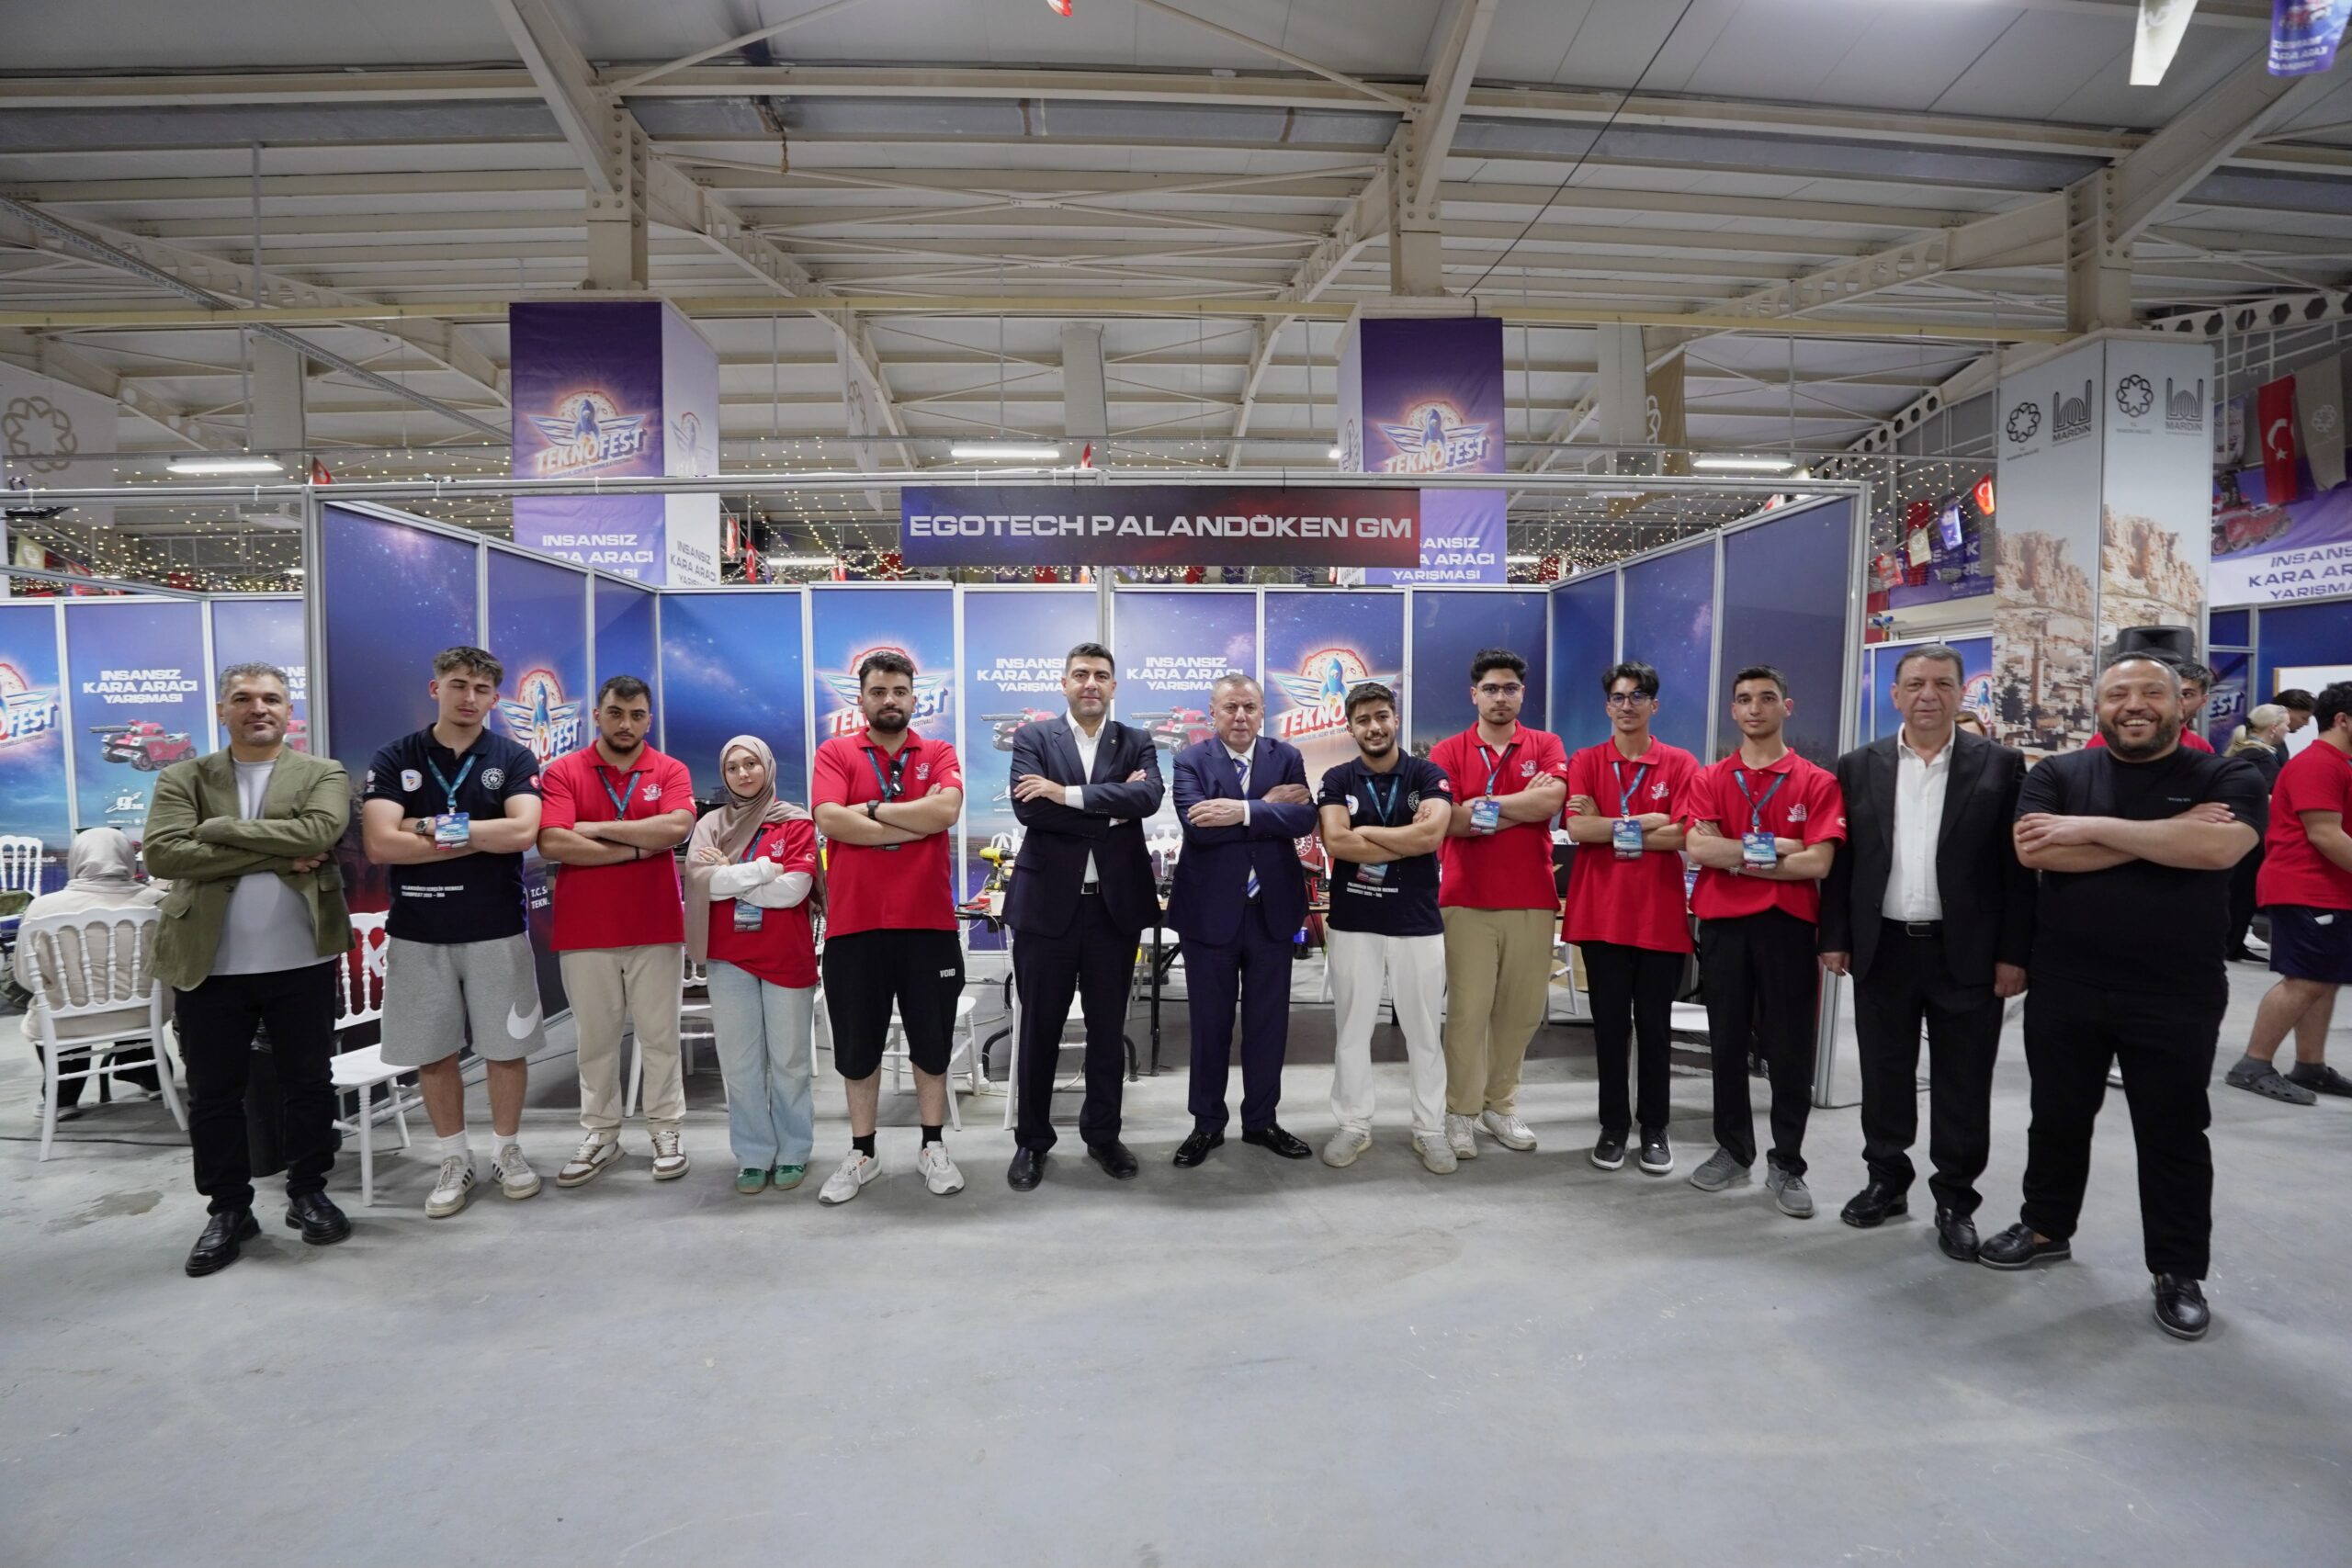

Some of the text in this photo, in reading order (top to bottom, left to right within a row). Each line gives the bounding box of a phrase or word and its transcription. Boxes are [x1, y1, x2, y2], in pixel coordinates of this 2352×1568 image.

[535, 428, 647, 472] TEKNOFEST
[1385, 436, 1490, 473] TEKNOFEST
[910, 514, 1412, 538] EGOTECH PALANDÖKEN GM
[542, 535, 638, 547] INSANSIZ
[1419, 537, 1480, 549] ANSIZ
[588, 551, 653, 563] ARACI
[1434, 553, 1495, 565] ARACI
[1392, 570, 1481, 581] YARIŞMASI
[2249, 569, 2316, 588] KARA
[1146, 657, 1227, 668] INSANSIZ
[100, 669, 182, 682] INSANSIZ
[977, 670, 1033, 681] KARA
[1126, 668, 1181, 680] KARA
[83, 680, 198, 694] KARA ARACI
[997, 682, 1064, 692] YARIŞMA
[1146, 681, 1214, 691] YARIŞMA
[102, 694, 183, 704] YARIŞMASI
[1278, 698, 1347, 737] TEKNO
[940, 968, 956, 977] VOID
